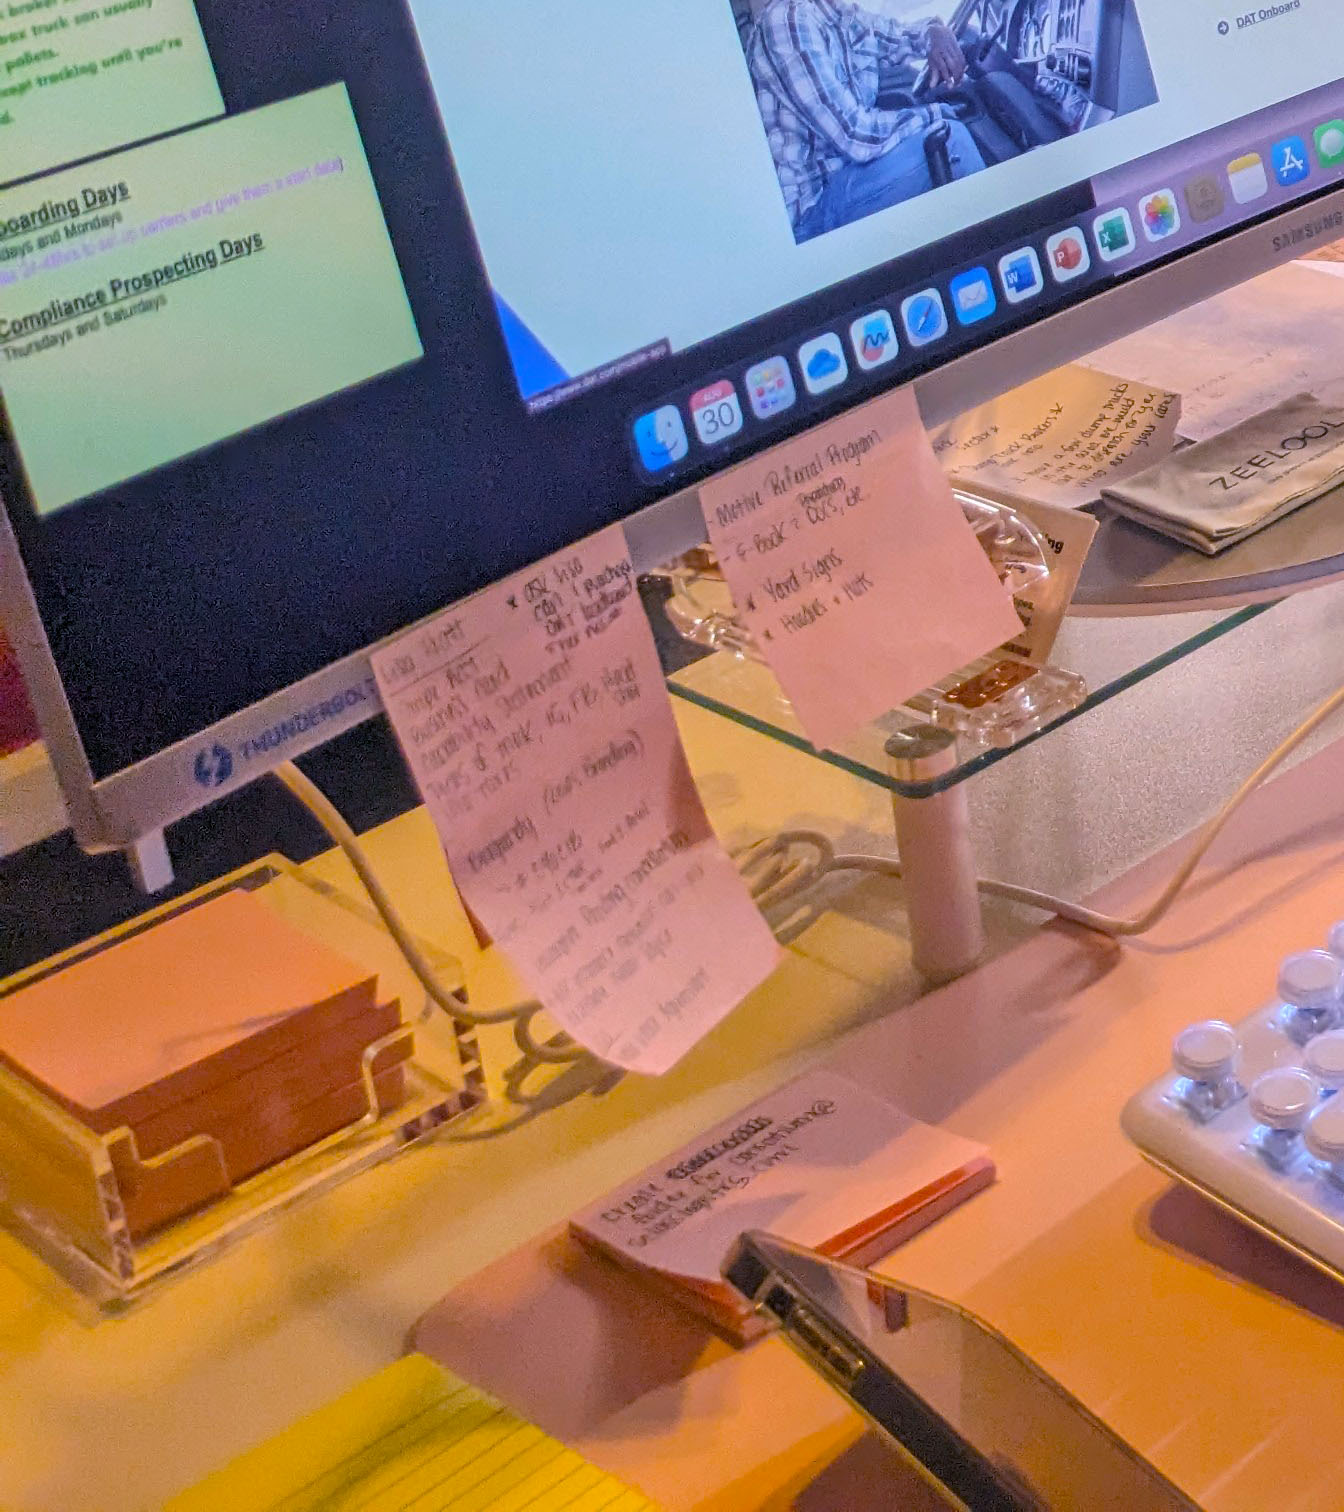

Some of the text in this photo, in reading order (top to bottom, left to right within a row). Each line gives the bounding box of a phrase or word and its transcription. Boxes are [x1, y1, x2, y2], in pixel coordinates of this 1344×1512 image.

[1236, 12, 1257, 29] DAT
[82, 181, 131, 209] Days
[64, 211, 123, 240] Mondays
[1272, 211, 1344, 252] SAMSUNG
[0, 232, 264, 340] Compliance Prospecting Days
[3, 326, 74, 363] Thursdays
[103, 294, 168, 327] Saturdays
[702, 402, 735, 435] 30
[242, 677, 377, 760] THUNDERBOLT
